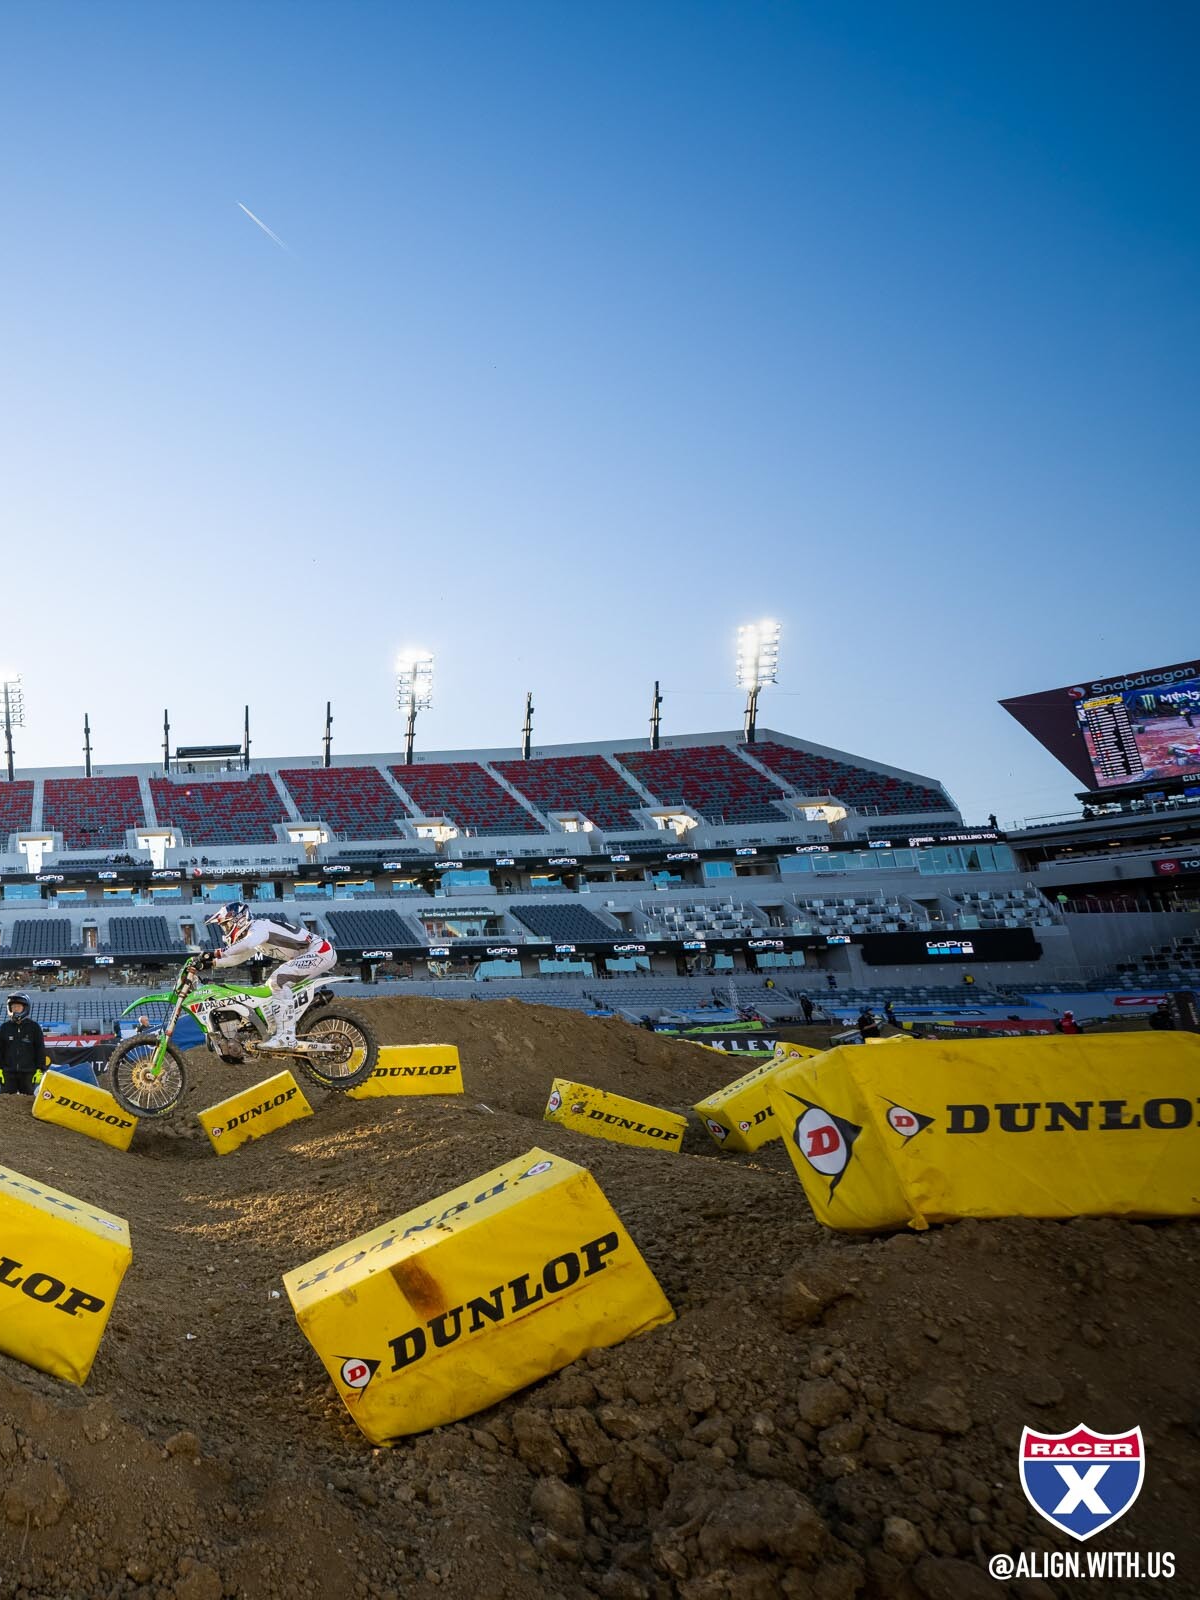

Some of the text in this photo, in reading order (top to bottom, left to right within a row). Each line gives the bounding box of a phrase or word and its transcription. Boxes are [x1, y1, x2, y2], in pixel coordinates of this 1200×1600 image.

[1091, 667, 1196, 694] Snapdragon
[206, 866, 256, 876] Snapdragon
[926, 940, 972, 948] GoPro
[374, 1065, 456, 1078] DUNLOP
[56, 1096, 132, 1128] DUNLOP
[226, 1087, 297, 1132] DUNLOP
[587, 1109, 679, 1141] DUNLOP
[894, 1097, 1200, 1134] D DUNLO
[807, 1125, 841, 1158] D
[347, 1231, 619, 1382] D DUNLOP
